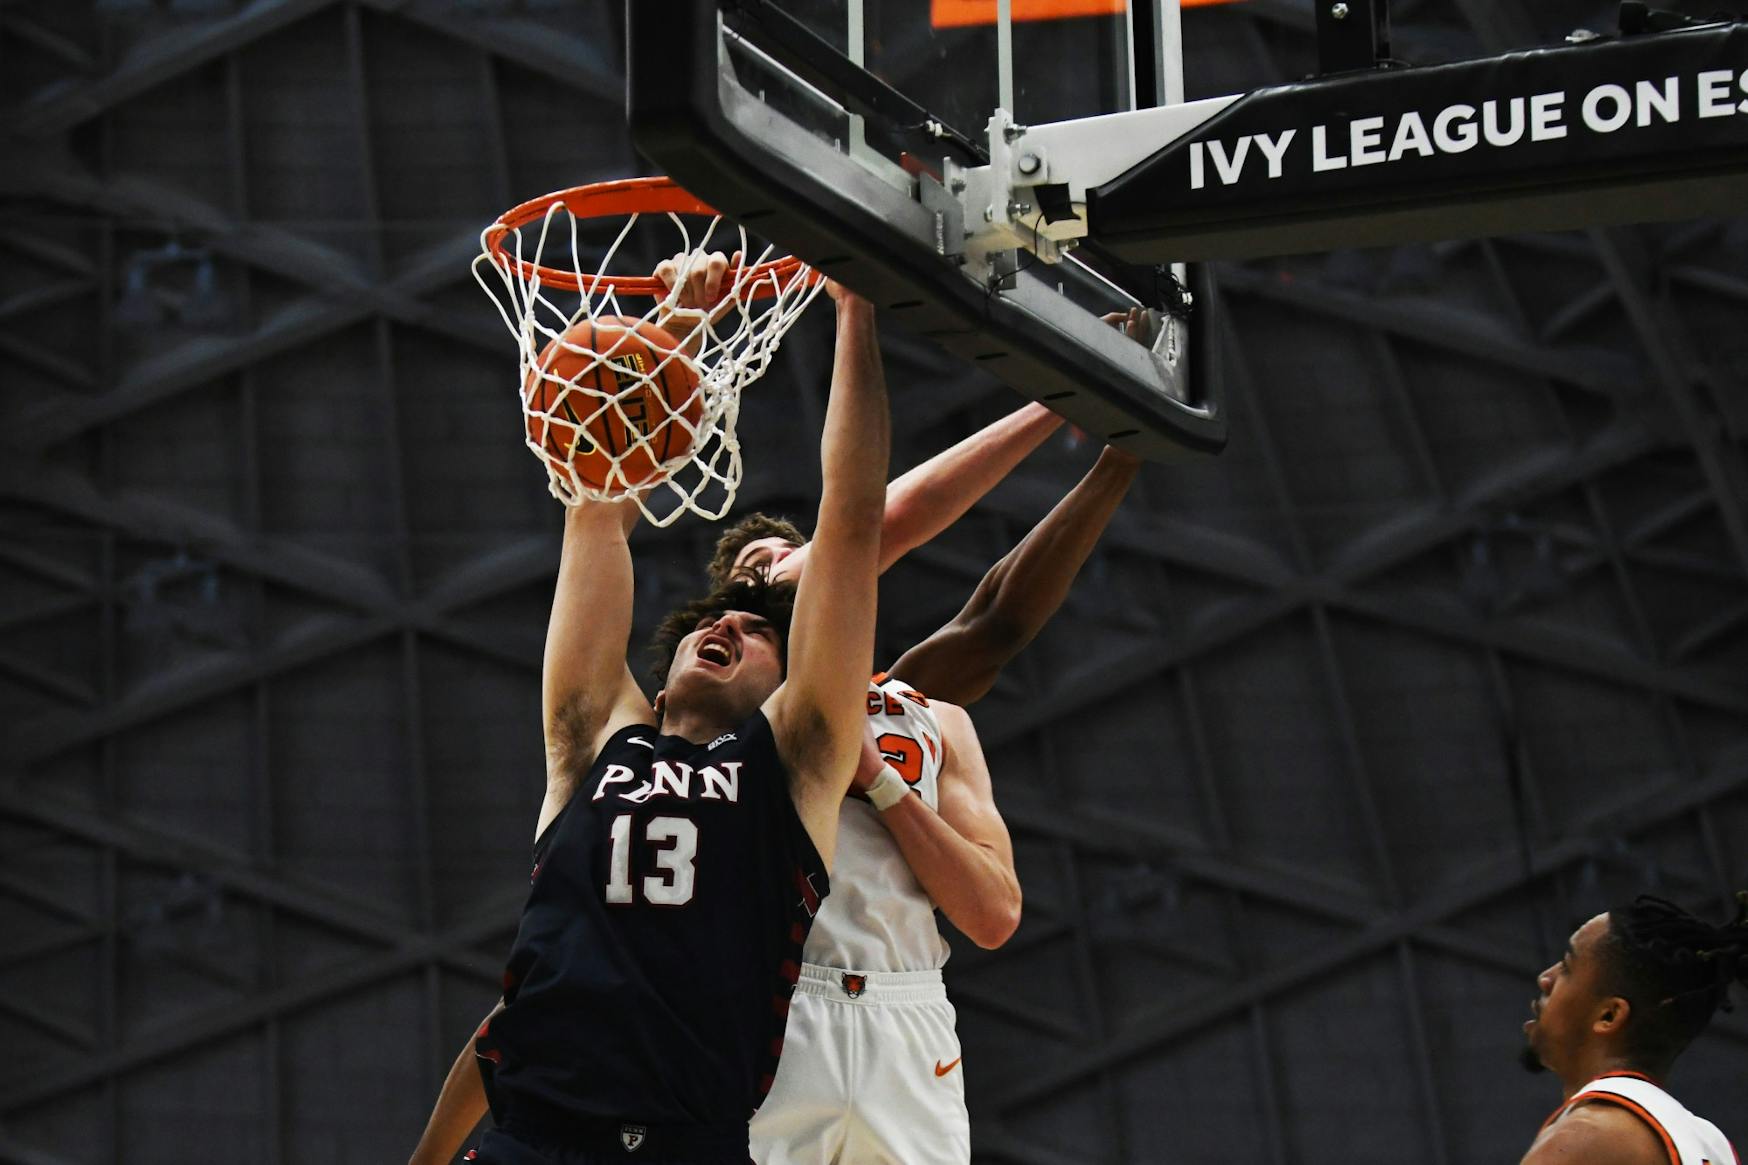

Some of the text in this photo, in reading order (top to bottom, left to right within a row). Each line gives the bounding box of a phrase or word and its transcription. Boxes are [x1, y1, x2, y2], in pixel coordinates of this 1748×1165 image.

[1189, 129, 1297, 190] IVY
[1312, 91, 1568, 173] LEAGUE
[1581, 76, 1680, 134] ON
[605, 814, 698, 906] 13
